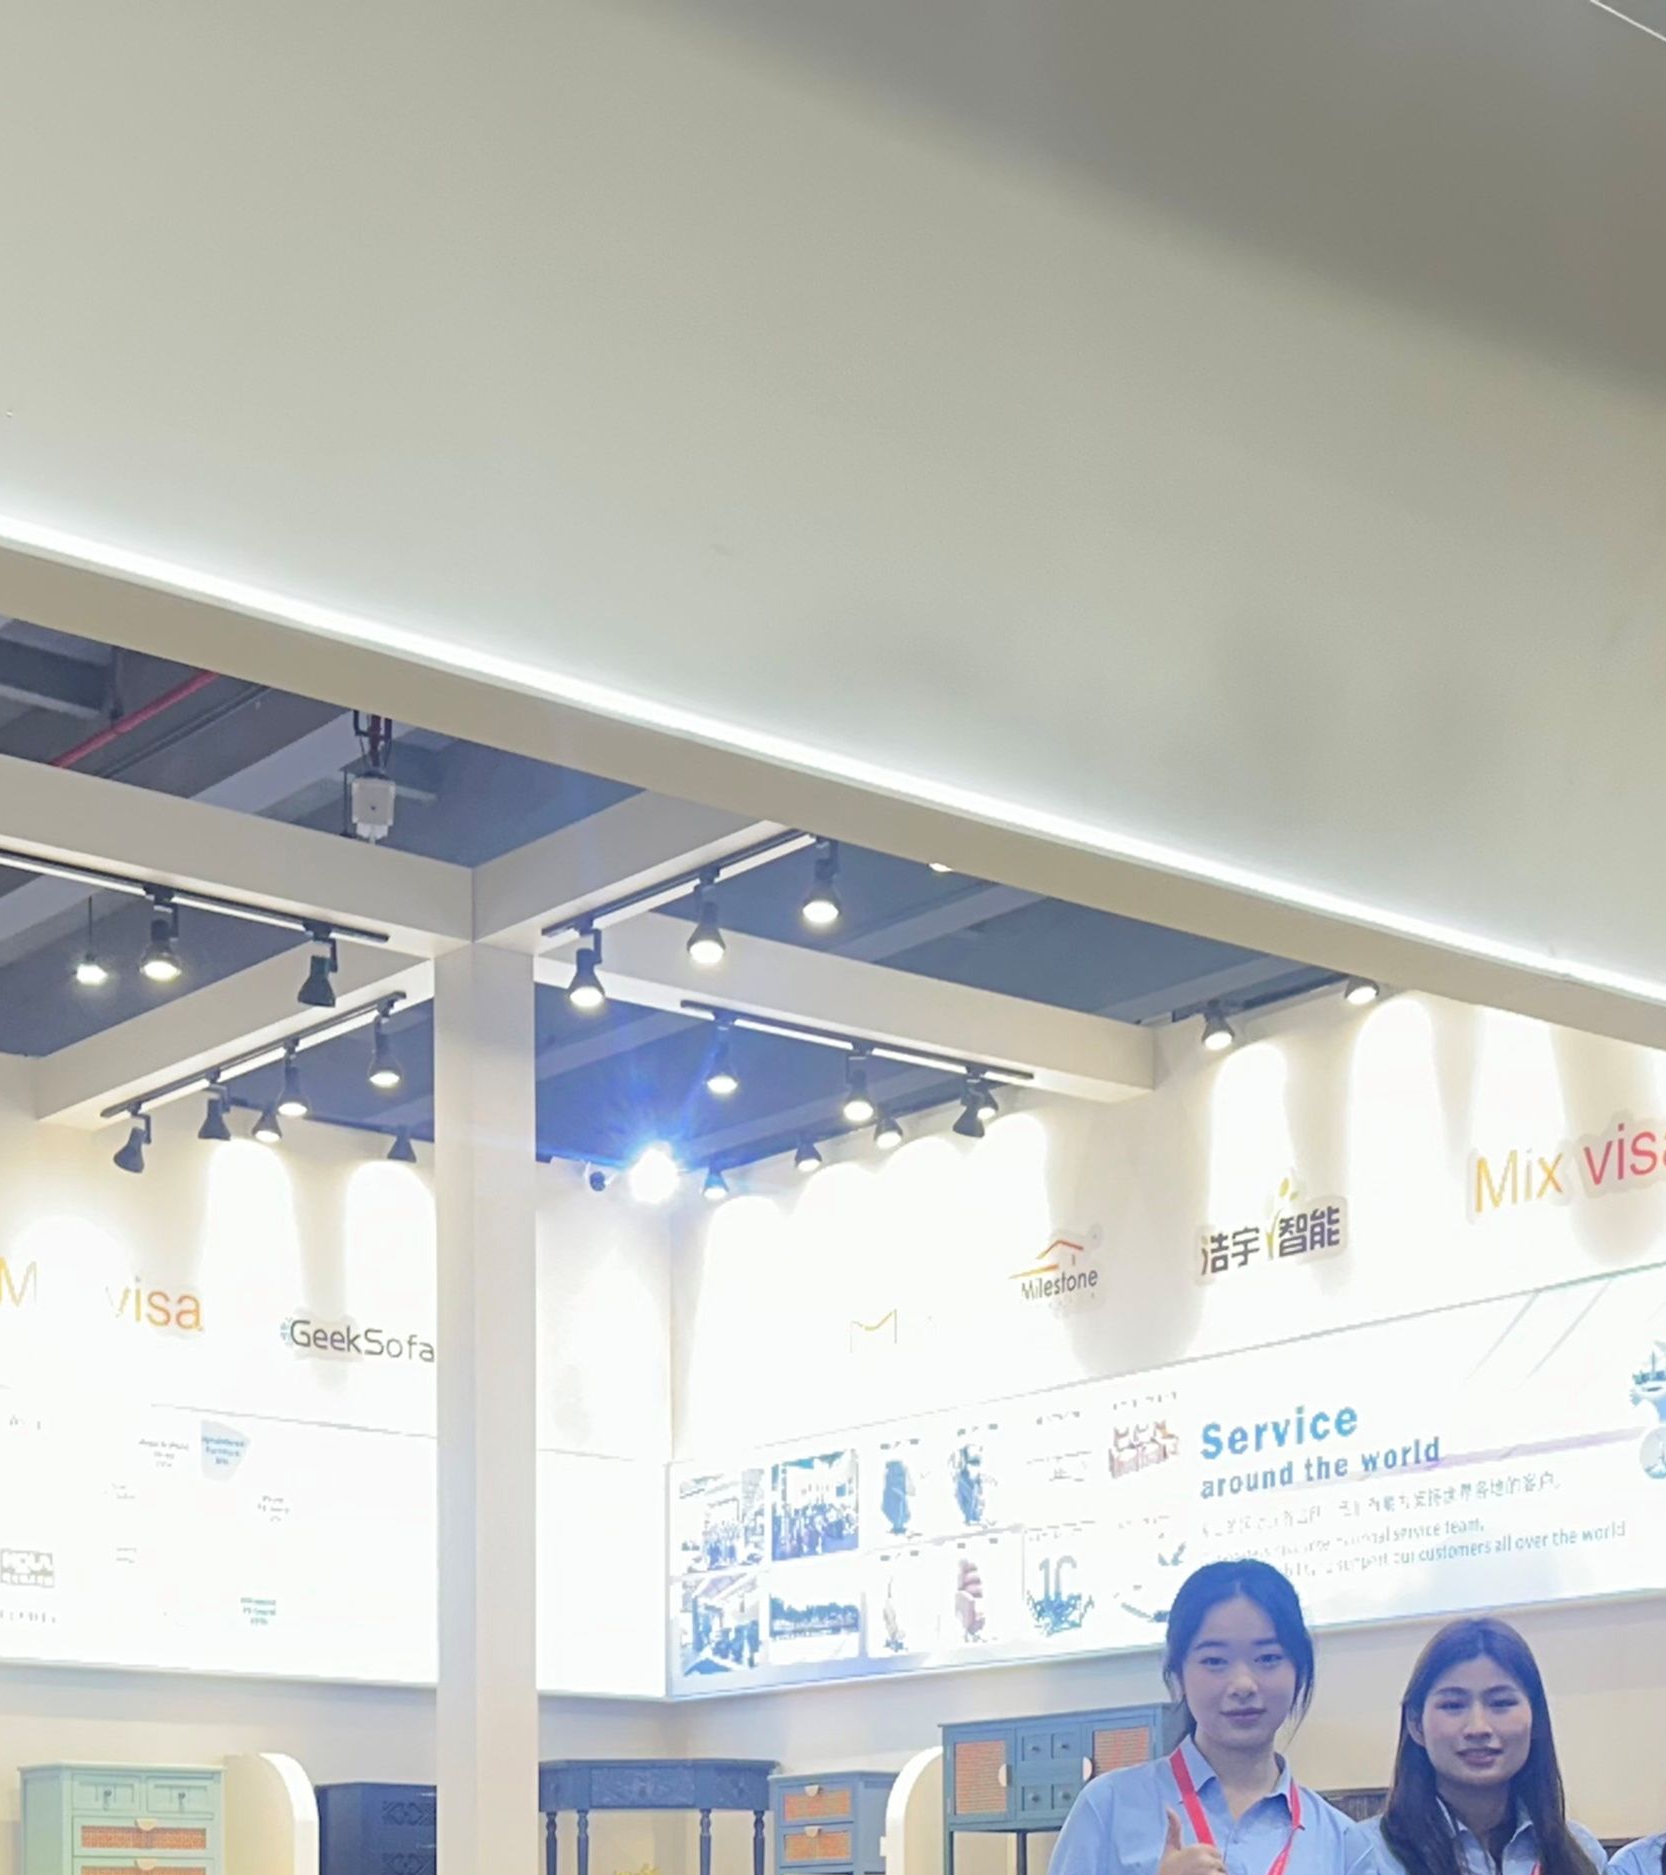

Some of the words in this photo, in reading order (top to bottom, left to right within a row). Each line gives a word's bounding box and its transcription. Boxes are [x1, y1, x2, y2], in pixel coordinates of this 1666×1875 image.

[1474, 1148, 1564, 1213] Mix
[105, 1275, 205, 1333] visa
[1021, 1269, 1099, 1300] Milestone
[289, 1318, 436, 1364] GeekSofa
[1200, 1404, 1359, 1460] Service
[1200, 1455, 1294, 1500] around
[1304, 1446, 1349, 1482] the
[1360, 1435, 1441, 1475] world
[1418, 1539, 1492, 1563] customers
[1494, 1535, 1512, 1552] all
[1515, 1534, 1548, 1550] over
[1552, 1528, 1577, 1546] the
[1581, 1520, 1627, 1541] world
